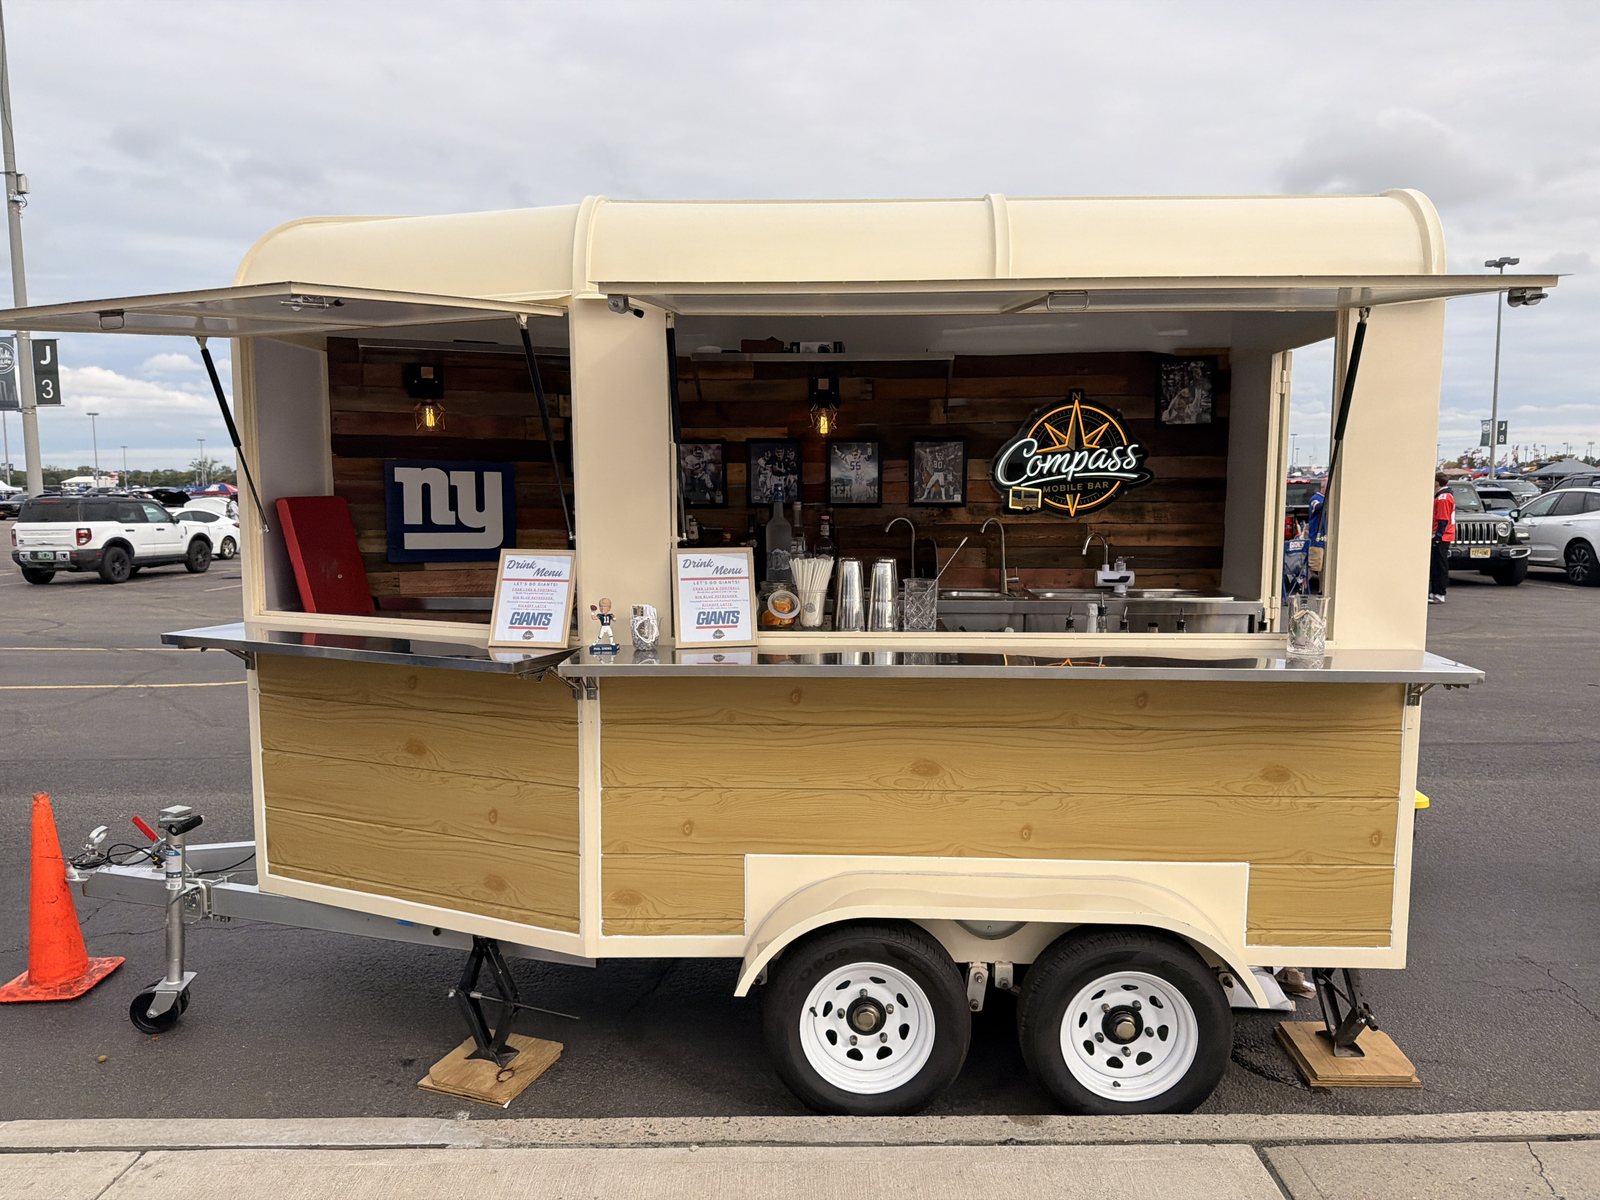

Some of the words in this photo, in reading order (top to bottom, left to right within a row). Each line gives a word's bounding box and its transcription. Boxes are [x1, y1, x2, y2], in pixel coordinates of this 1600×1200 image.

[40, 345, 51, 365] J
[41, 379, 54, 399] 3
[1072, 392, 1081, 400] N
[995, 438, 1141, 485] Compass
[1043, 483, 1083, 493] MOBILE
[1087, 481, 1109, 489] BAR
[506, 560, 536, 570] Drink
[682, 558, 714, 569] Drink
[533, 568, 563, 577] Menu
[712, 566, 743, 575] Menu
[509, 611, 553, 626] GIANTS
[696, 610, 740, 625] GIANTS
